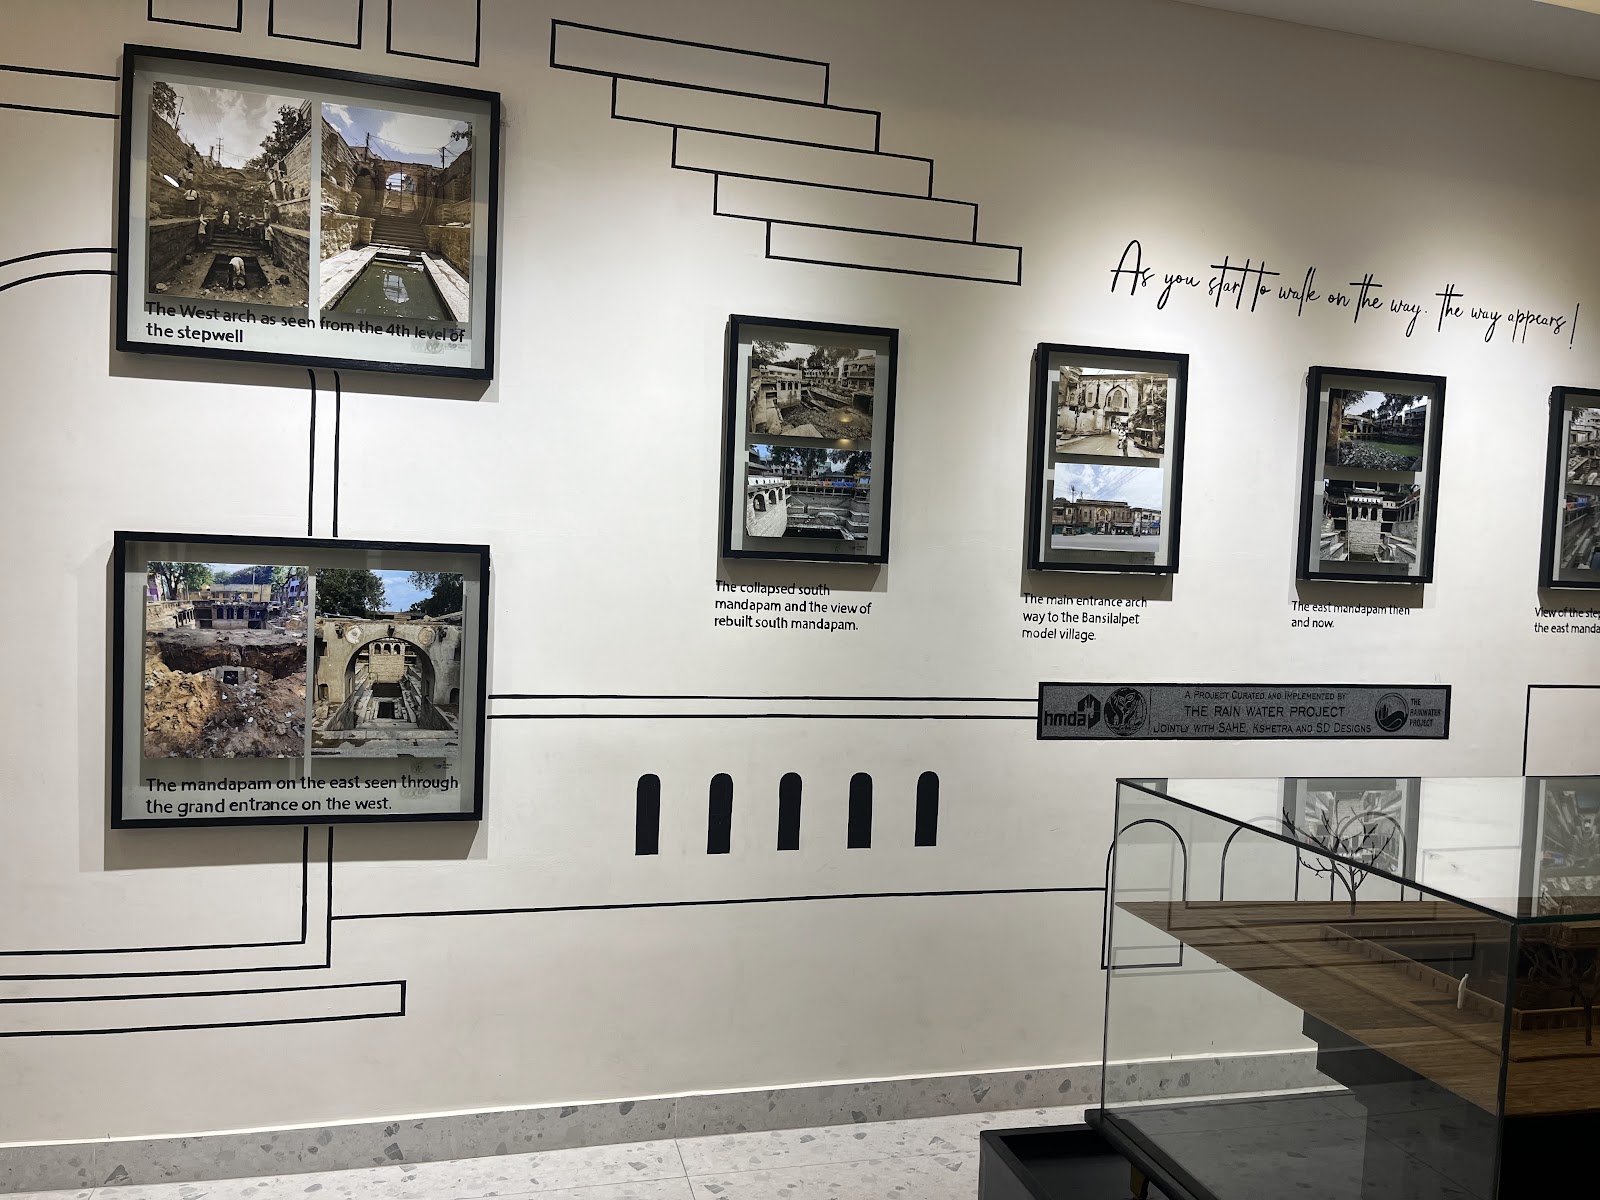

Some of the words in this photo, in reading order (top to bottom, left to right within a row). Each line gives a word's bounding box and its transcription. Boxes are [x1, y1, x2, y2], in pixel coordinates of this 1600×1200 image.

[1111, 240, 1155, 295] As
[1157, 272, 1200, 310] you
[1208, 256, 1251, 310] start
[1250, 261, 1280, 312] to
[1278, 266, 1321, 316] walk
[1328, 293, 1349, 306] on
[1349, 273, 1383, 323] the
[1435, 284, 1464, 333] the
[1471, 307, 1502, 343] way
[145, 301, 176, 317] The
[179, 304, 220, 320] West
[223, 309, 256, 324] arch
[260, 314, 276, 325] as
[281, 317, 315, 328] seen
[320, 317, 354, 333] from
[358, 320, 383, 335] the
[385, 323, 410, 337] 4th
[414, 326, 446, 341] level
[450, 329, 465, 343] of
[146, 322, 174, 338] the
[177, 325, 243, 343] stepwell
[716, 579, 737, 593] The
[740, 581, 795, 596] collapsed
[798, 583, 830, 596] south
[715, 599, 781, 613] mandapam
[784, 601, 807, 612] and
[808, 601, 828, 613] the
[830, 603, 858, 614] view
[859, 602, 872, 614] of
[1023, 592, 1043, 604] The
[1046, 594, 1073, 605] main
[1076, 595, 1122, 607] entrance
[1125, 596, 1147, 608] arch
[1291, 600, 1310, 612] The
[1312, 602, 1332, 613] east
[1333, 603, 1387, 617] mandapam
[1389, 604, 1410, 616] then
[1534, 606, 1557, 618] View
[1558, 606, 1569, 618] of
[1568, 607, 1583, 618] the
[714, 615, 753, 628] rebuilt
[755, 616, 788, 629] south
[791, 618, 859, 632] mandapam.
[1023, 612, 1045, 625] way
[1047, 611, 1059, 623] to
[1061, 611, 1079, 623] the
[1082, 612, 1140, 627] Bansilalpet
[1291, 617, 1310, 628] and
[1312, 619, 1334, 628] now.
[1022, 627, 1057, 639] model
[1059, 628, 1097, 643] village.
[1534, 622, 1549, 633] the
[1550, 622, 1569, 633] east
[1184, 690, 1191, 699] A
[1410, 698, 1421, 706] THE
[1043, 710, 1087, 727] hmda
[1184, 705, 1208, 717] THE
[1214, 705, 1241, 717] RAIN
[1245, 706, 1284, 718] WATER
[1289, 706, 1346, 718] PROJECT
[1316, 722, 1330, 733] SD
[1410, 718, 1433, 727] PROJECT
[145, 778, 177, 792] The
[181, 777, 272, 793] mandapam
[276, 779, 296, 790] on
[300, 775, 326, 790] the
[329, 775, 361, 789] east
[364, 778, 397, 789] seen
[401, 774, 459, 791] through
[146, 799, 173, 814] the
[177, 798, 225, 817] grand
[229, 797, 298, 812] entrance
[301, 800, 321, 811] on
[325, 797, 351, 810] the
[355, 797, 392, 810] west.
